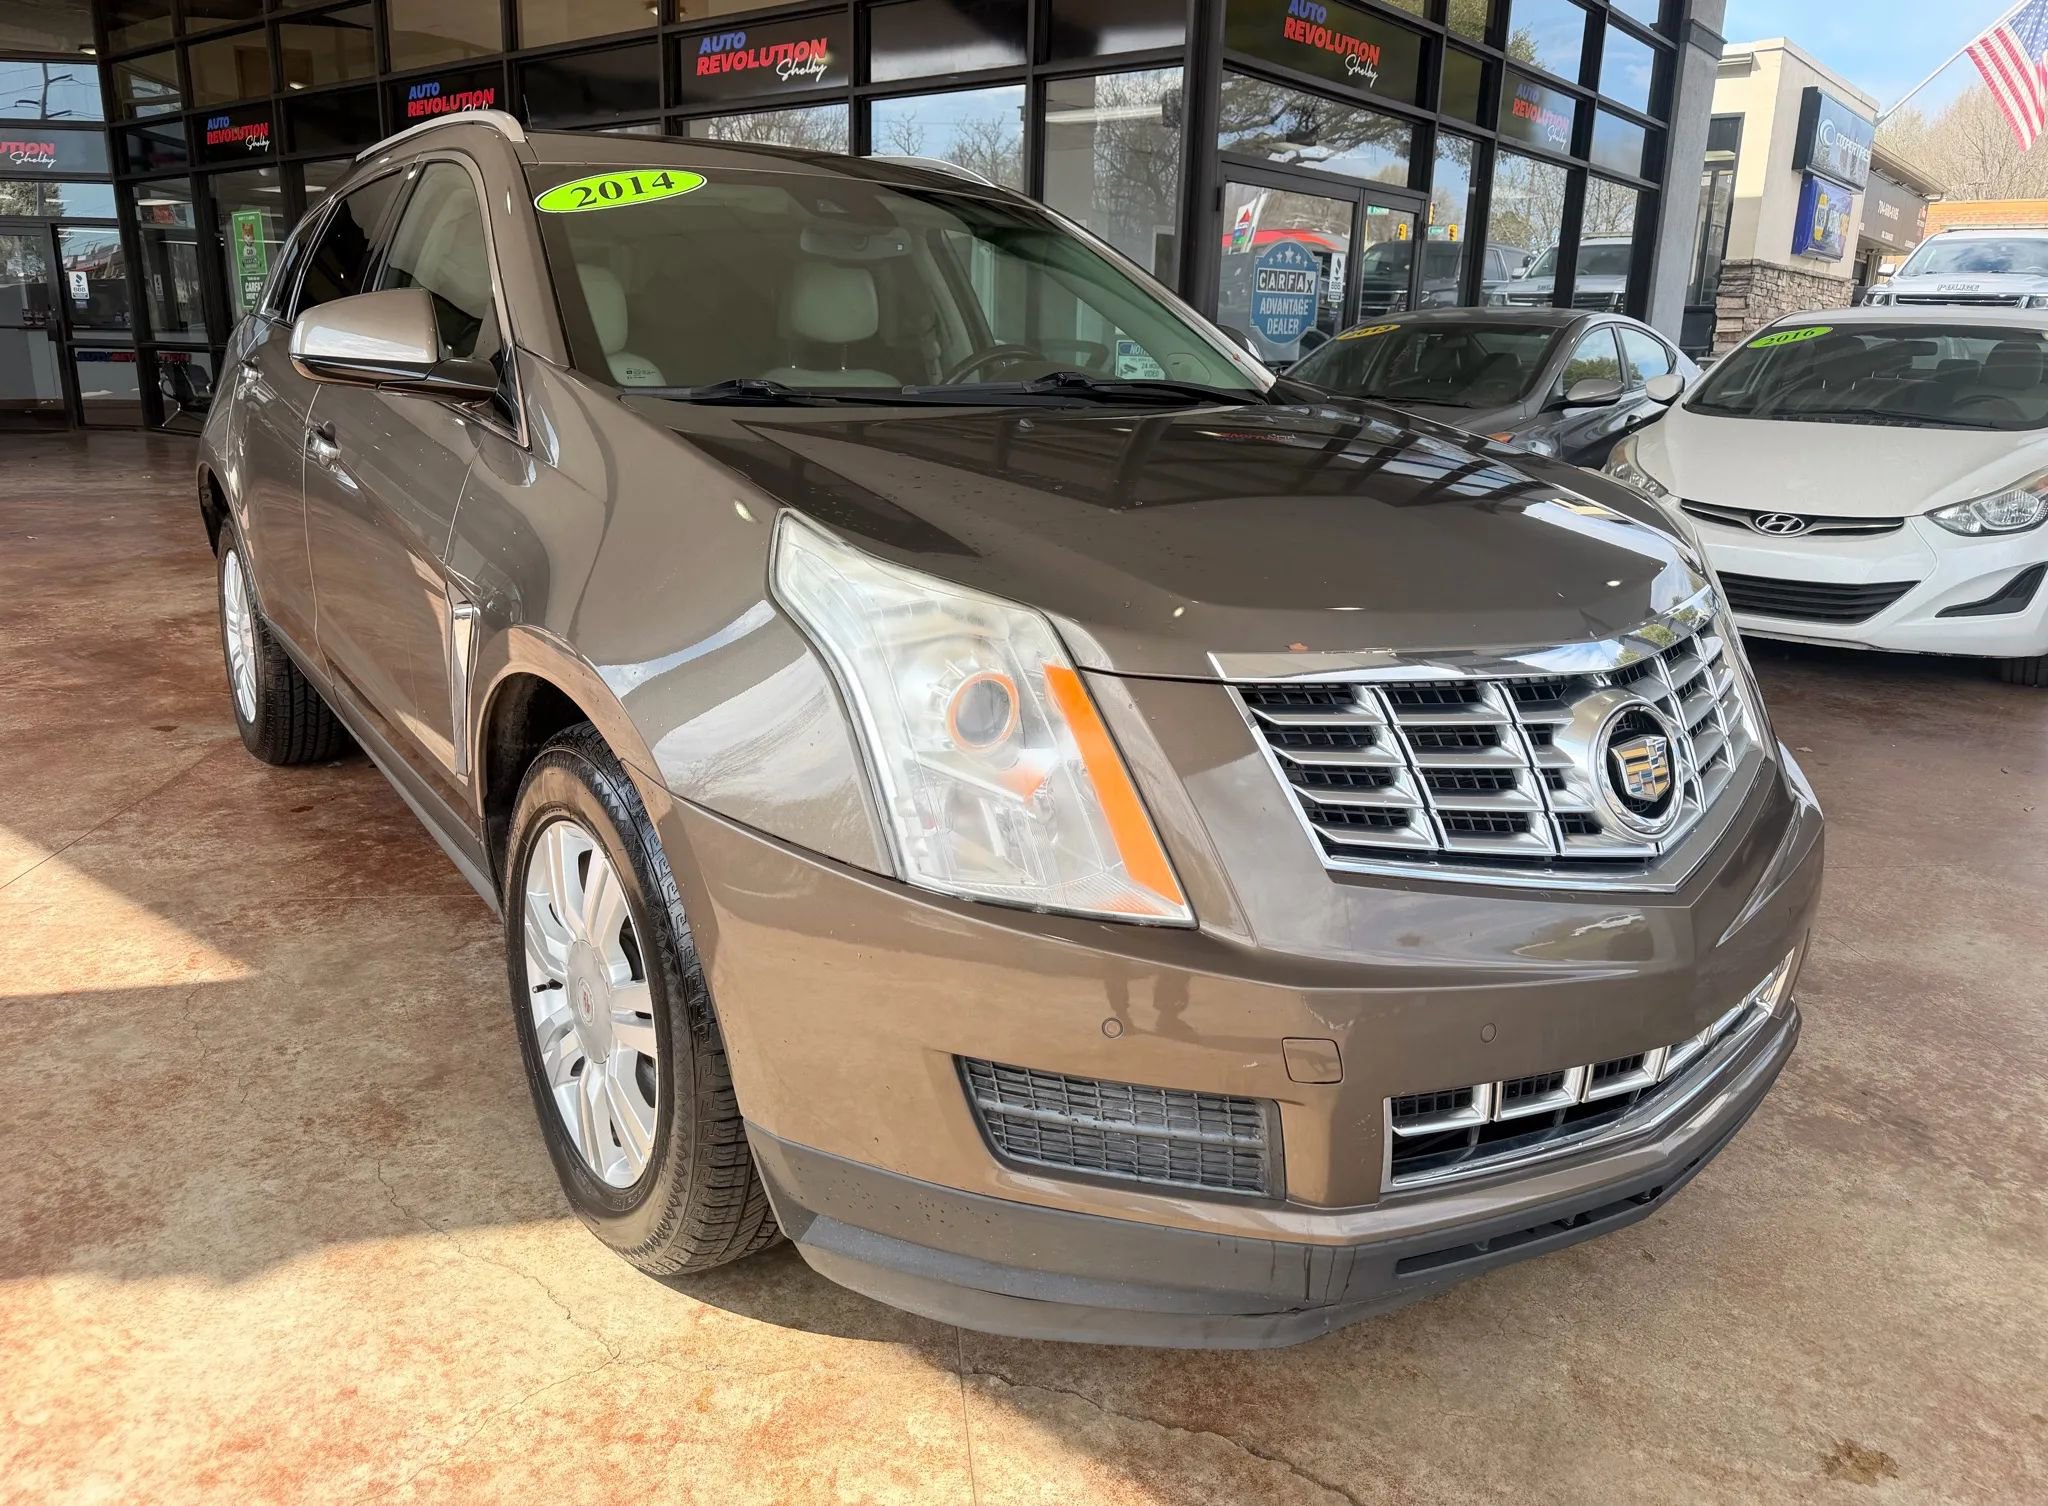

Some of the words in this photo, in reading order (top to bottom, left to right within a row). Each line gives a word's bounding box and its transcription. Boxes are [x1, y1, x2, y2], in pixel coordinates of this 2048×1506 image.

[1288, 0, 1327, 23] AUTO
[699, 31, 746, 54] AUTO
[1283, 16, 1380, 66] REVOLUTION
[696, 38, 827, 75] REVOLUTION
[776, 53, 827, 82] Shelby
[1344, 54, 1378, 88] Shelby
[407, 88, 495, 117] REVOLUTION
[409, 82, 440, 100] AUTO
[207, 116, 230, 130] AUTO
[207, 122, 269, 145] REVOLUTION
[9, 151, 57, 168] Shelby
[570, 172, 675, 207] 2014
[1258, 271, 1314, 294] CARFAX
[1259, 297, 1309, 314] ADVANTAGE
[1266, 318, 1299, 335] DEALER
[1762, 329, 1815, 346] 2016
